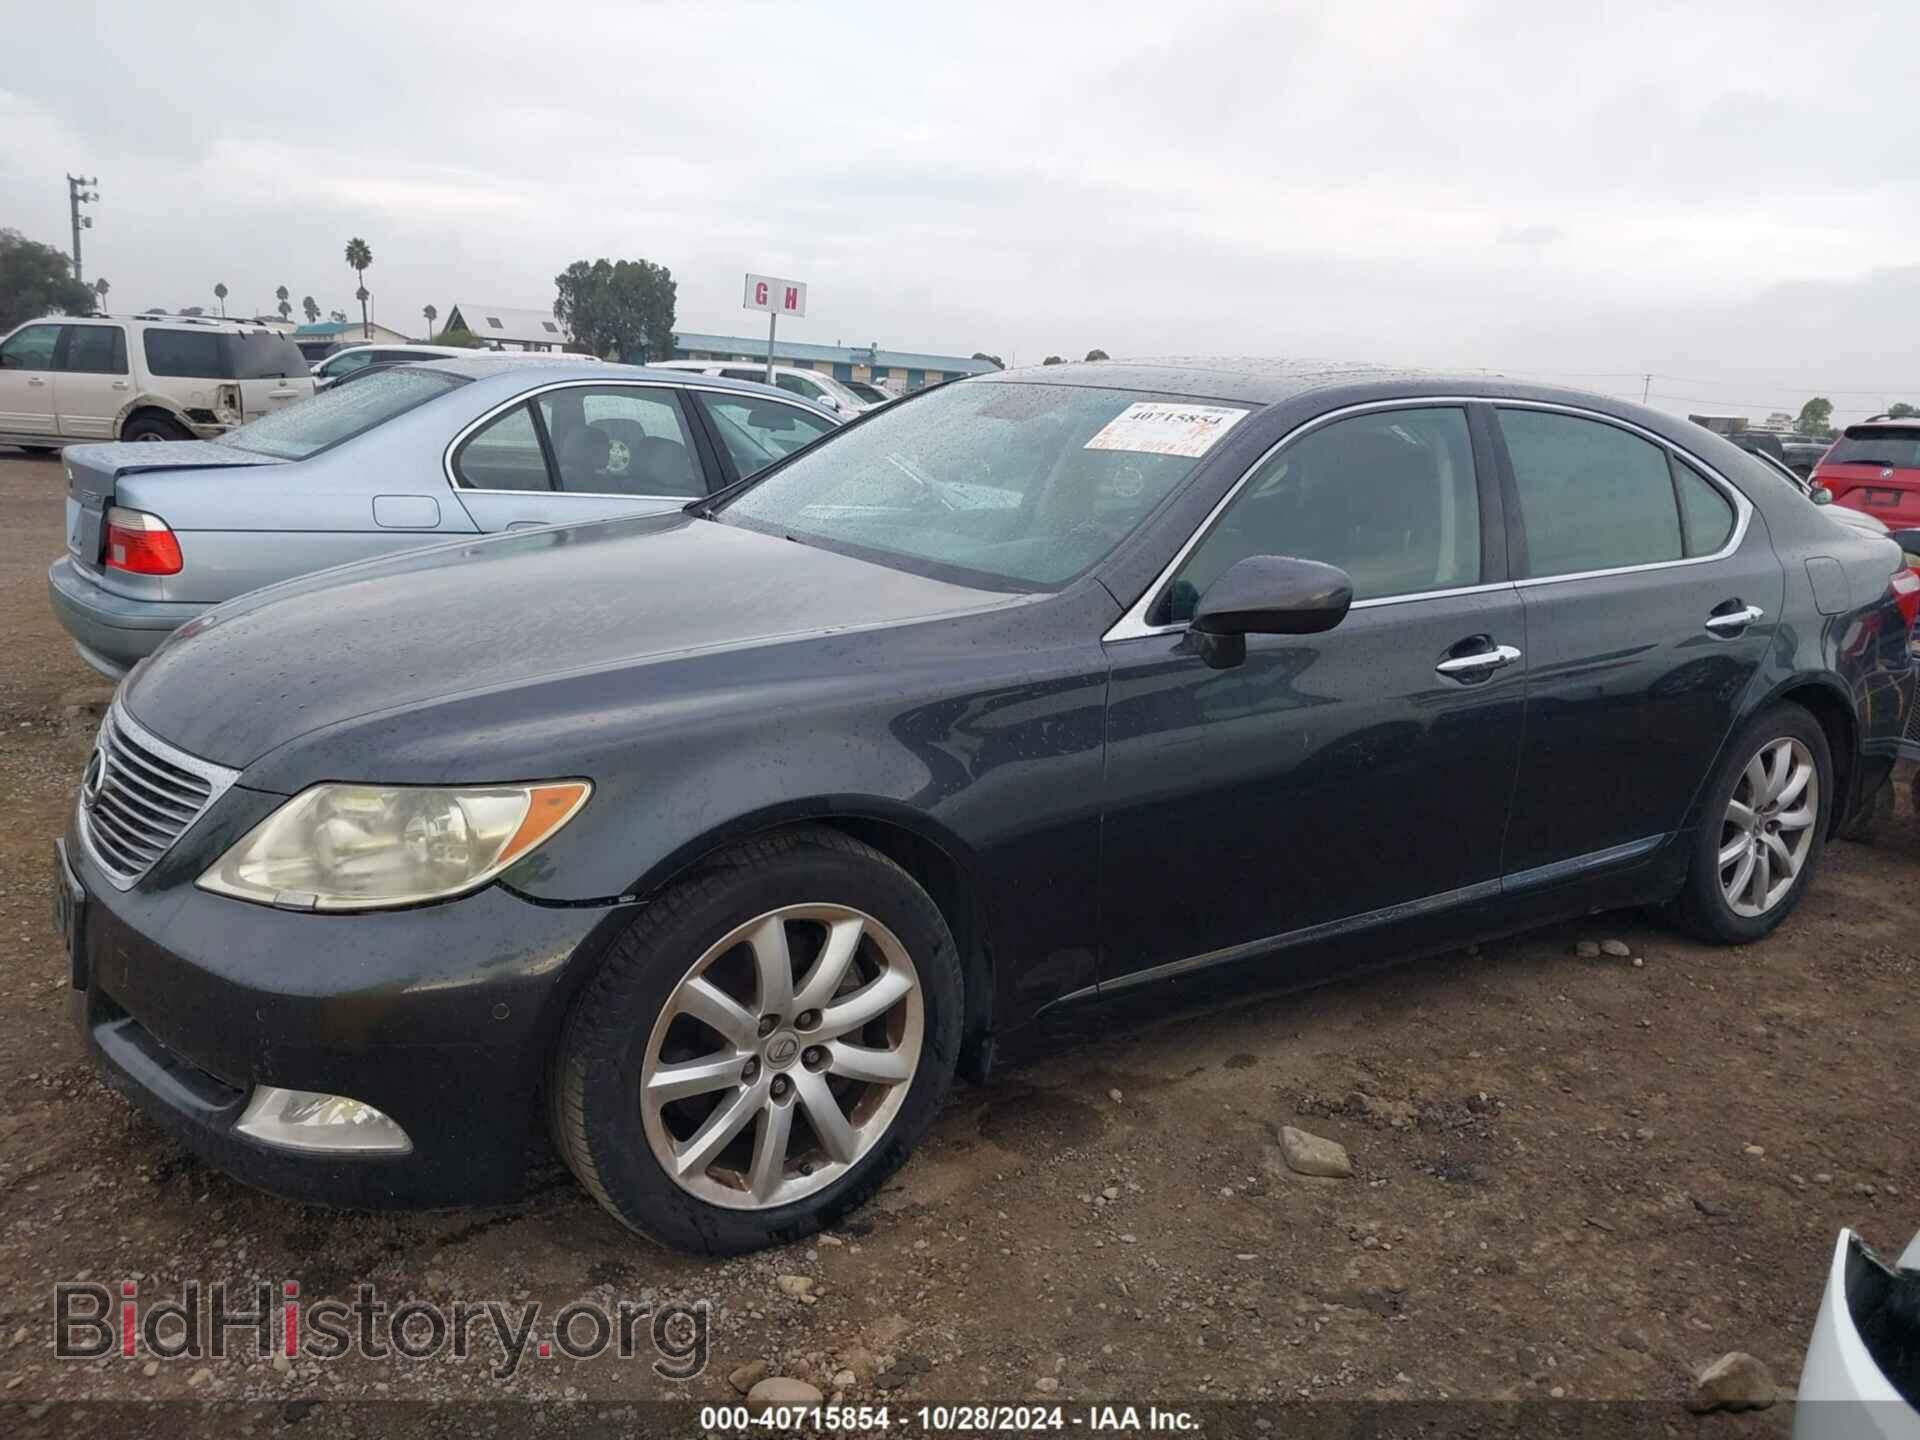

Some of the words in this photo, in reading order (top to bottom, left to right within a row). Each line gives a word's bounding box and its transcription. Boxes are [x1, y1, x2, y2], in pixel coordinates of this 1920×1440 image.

[755, 282, 768, 305] G
[785, 287, 797, 310] H
[1129, 411, 1223, 425] 40715854
